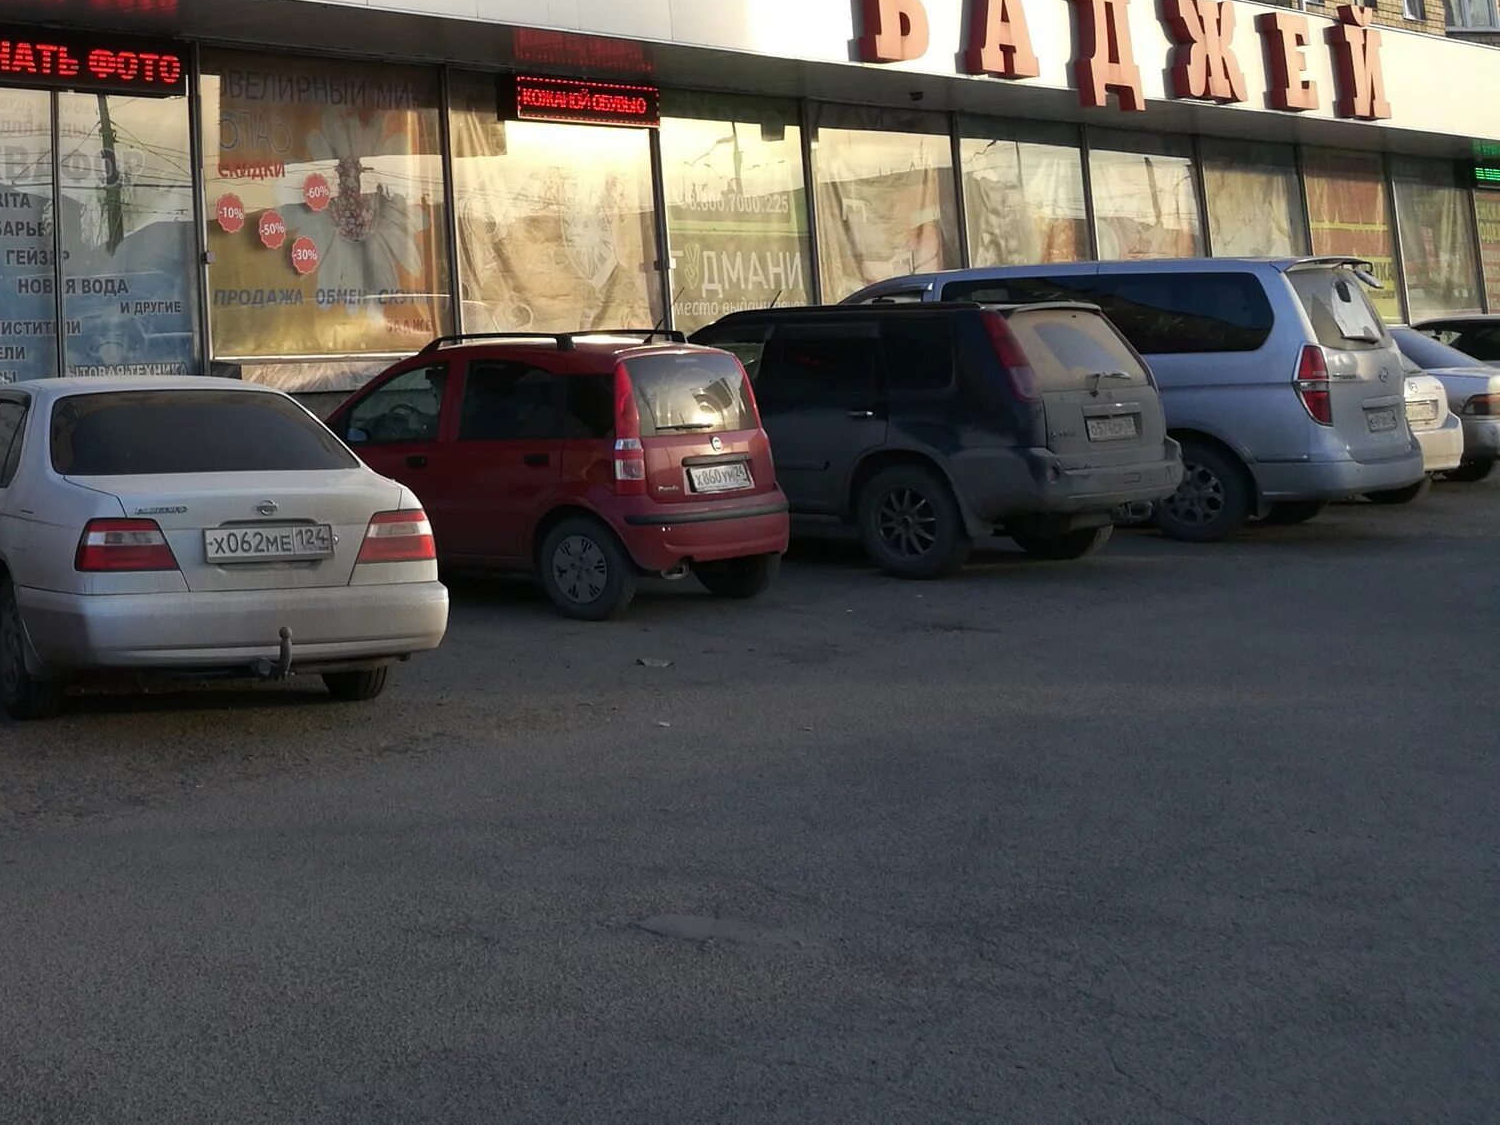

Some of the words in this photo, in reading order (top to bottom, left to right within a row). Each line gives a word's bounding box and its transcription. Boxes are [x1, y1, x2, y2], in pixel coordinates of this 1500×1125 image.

[89, 49, 181, 83] ФОТО
[522, 88, 591, 110] КОЖАНОЙ
[592, 94, 647, 114] ОБУВЬЮ
[218, 160, 285, 180] СКИДКИ
[307, 184, 330, 199] -60%
[218, 205, 244, 221] -10%
[260, 222, 285, 236] -50%
[293, 247, 318, 262] -30%
[18, 278, 76, 295] НОВЯ
[81, 277, 129, 295] ВОДА
[213, 289, 304, 308] ПРОДАЖА
[120, 302, 130, 313] И
[133, 300, 182, 316] ДРУГИЕ
[674, 301, 718, 316] место
[296, 528, 329, 545] 124
